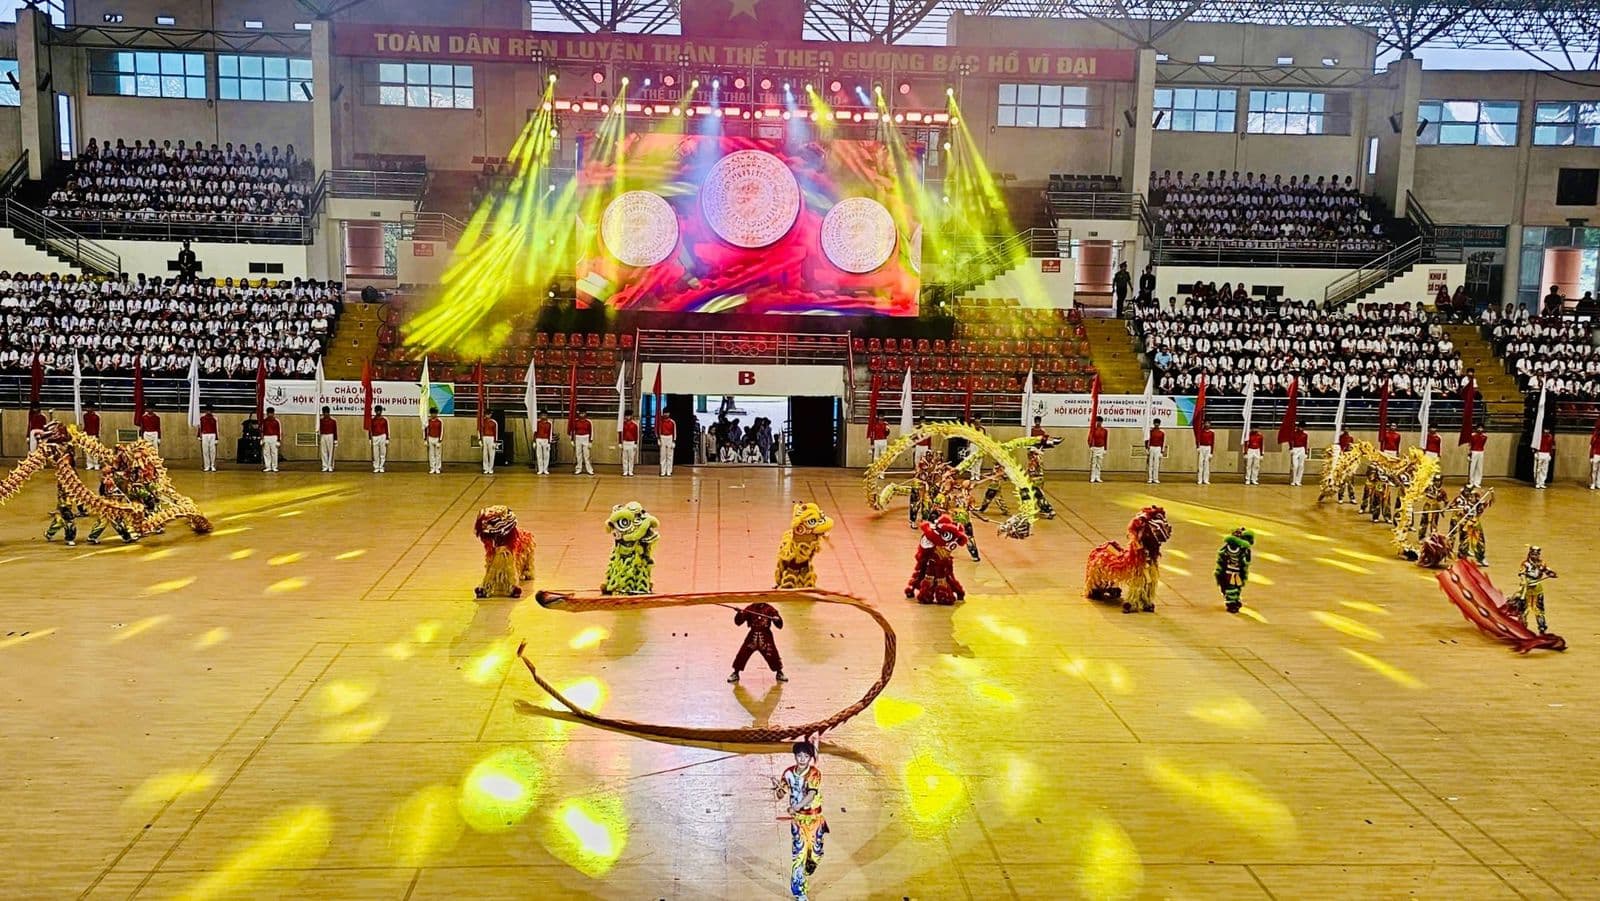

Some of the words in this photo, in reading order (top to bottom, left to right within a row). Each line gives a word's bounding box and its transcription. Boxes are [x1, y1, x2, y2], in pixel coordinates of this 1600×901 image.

[374, 31, 440, 53] TOÀN
[449, 33, 500, 55] DÂN
[508, 35, 558, 58] RÈN
[566, 39, 643, 62] LUYỆN
[652, 41, 716, 63] THÂN
[724, 41, 769, 65] THỂ
[775, 49, 834, 68] THEO
[933, 51, 980, 73] BÁC
[988, 50, 1020, 74] HỒ
[1057, 56, 1097, 78] ĐẠI
[738, 371, 755, 385] B
[334, 385, 358, 394] CHÀO
[292, 394, 307, 405] HỘI
[309, 394, 330, 404] KỎE
[1054, 405, 1067, 416] HỘI
[1069, 405, 1087, 415] KHỎE
[1158, 408, 1171, 418] THỌ
